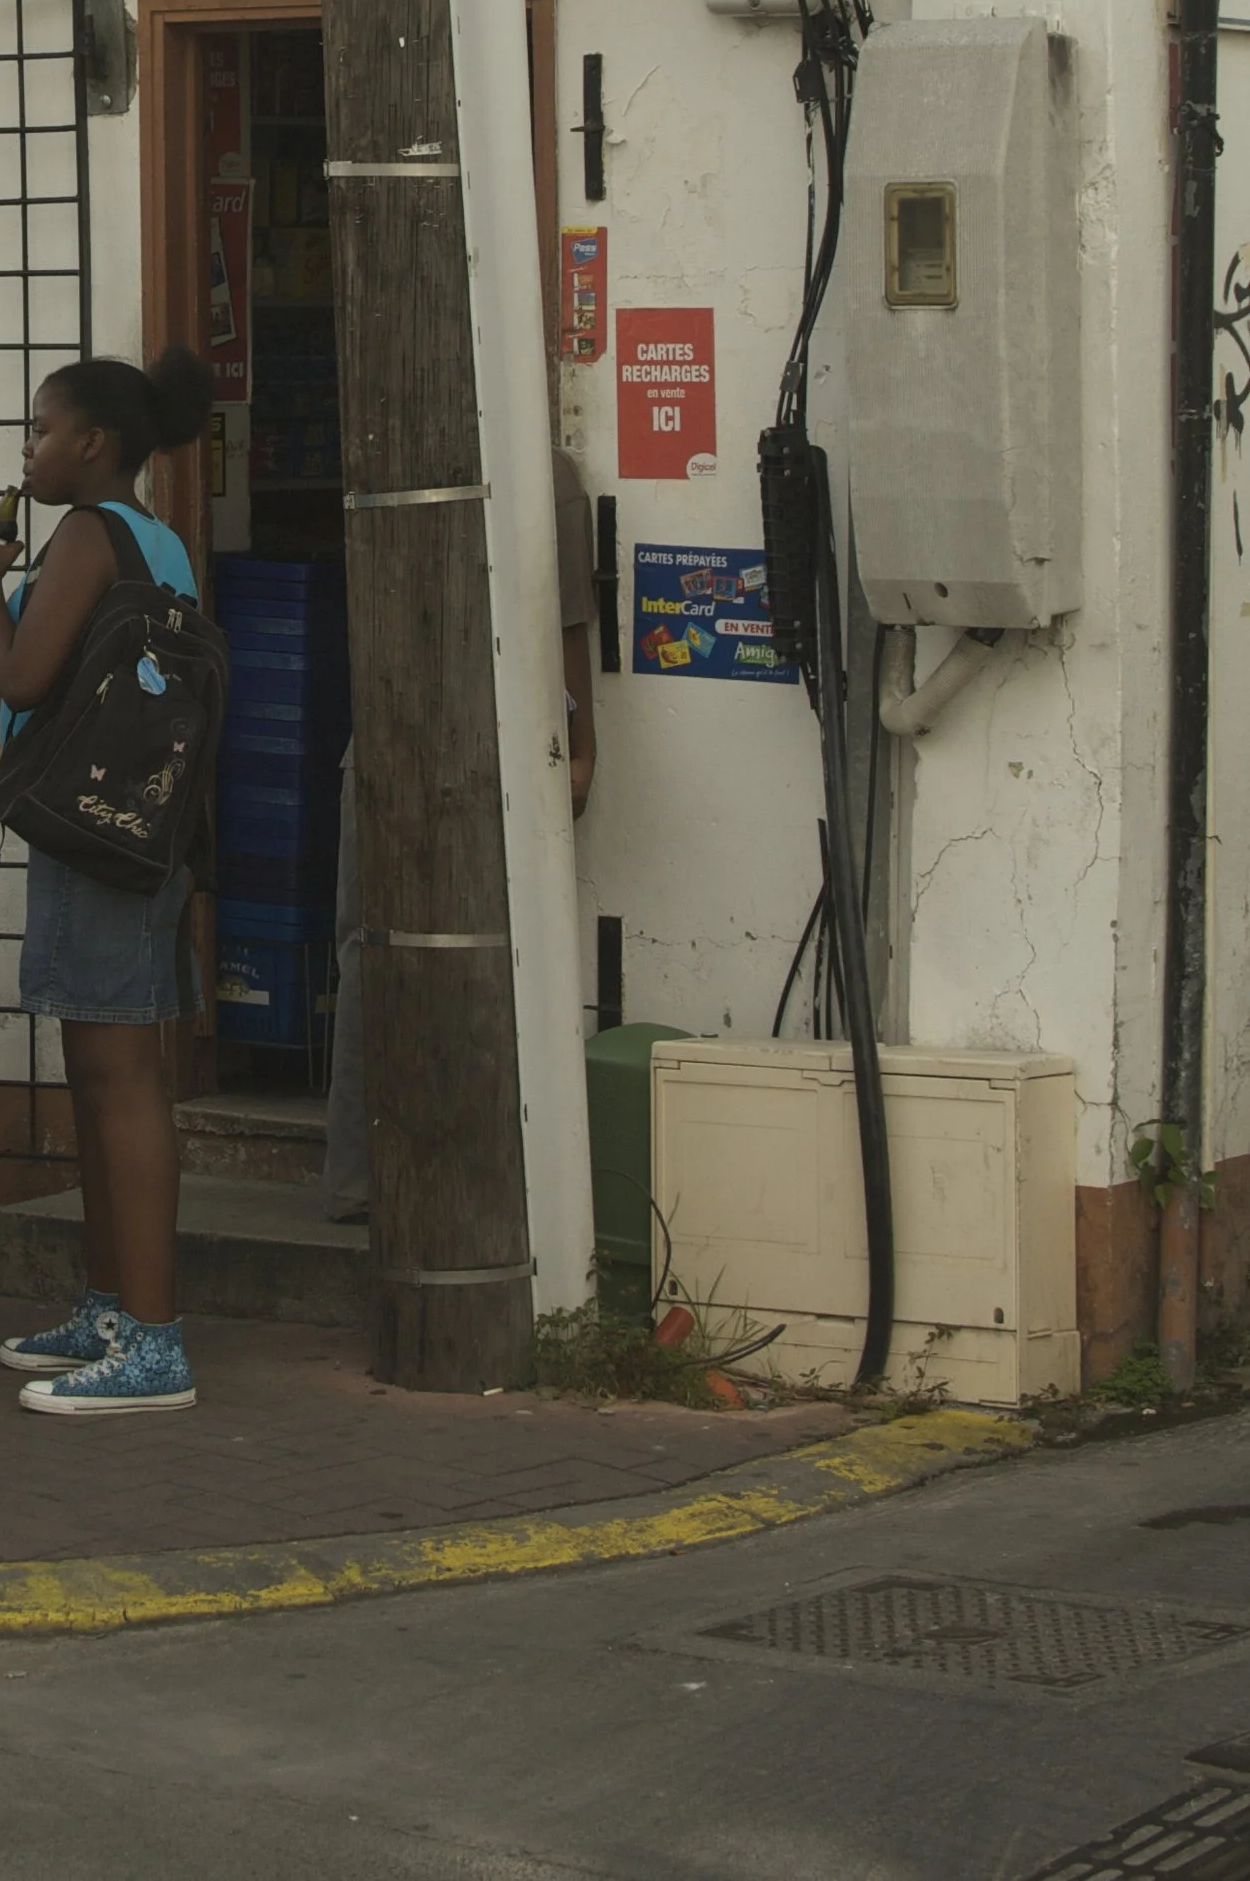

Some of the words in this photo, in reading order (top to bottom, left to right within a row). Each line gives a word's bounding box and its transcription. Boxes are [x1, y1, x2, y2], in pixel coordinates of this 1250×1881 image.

[211, 190, 246, 213] ard
[637, 343, 694, 361] CARTES
[226, 362, 244, 378] ICI
[622, 365, 710, 382] RECHARGES
[647, 389, 658, 399] en
[661, 387, 686, 399] vente
[653, 406, 681, 431] ICI
[638, 551, 674, 565] CARTES
[675, 551, 728, 568] PRÉPAYÉES
[641, 596, 716, 617] InterCard
[724, 622, 739, 632] EN
[734, 641, 777, 668] Amig
[77, 795, 116, 826] City
[114, 812, 151, 839] Chic
